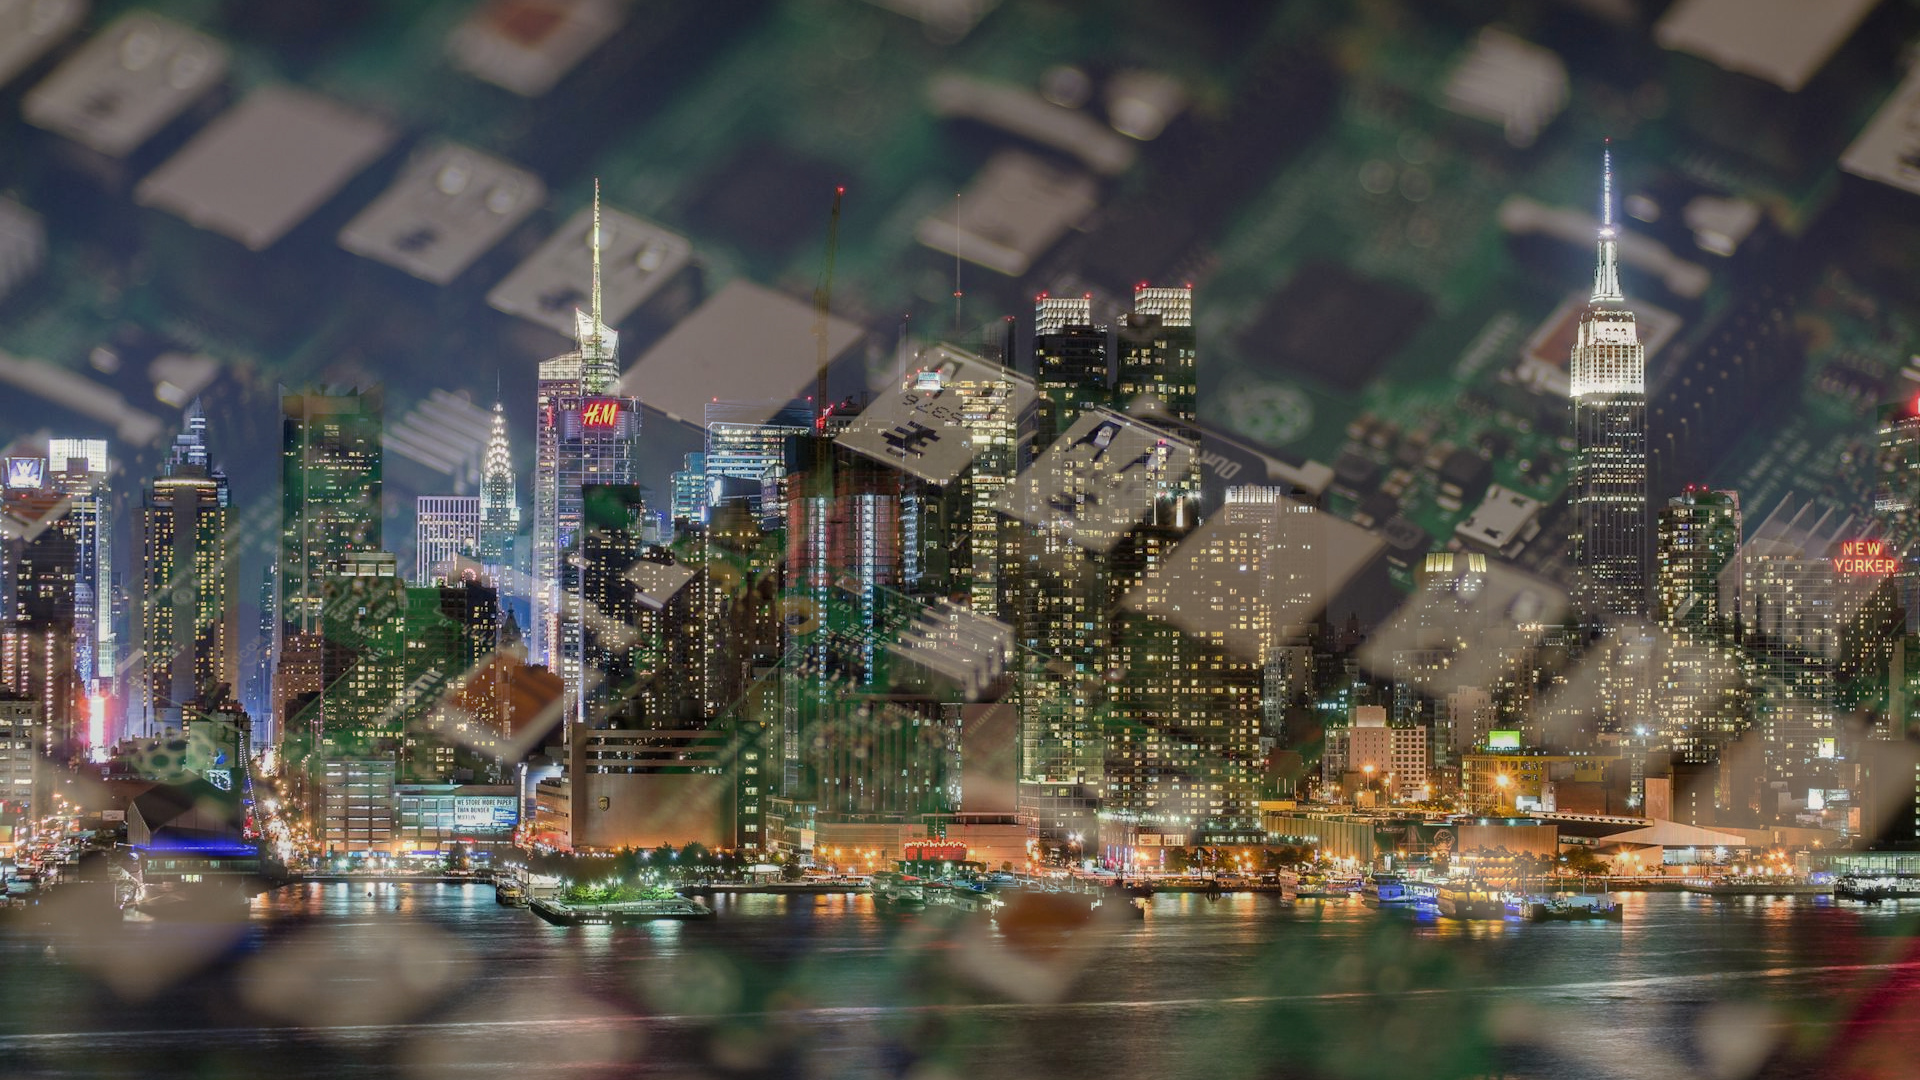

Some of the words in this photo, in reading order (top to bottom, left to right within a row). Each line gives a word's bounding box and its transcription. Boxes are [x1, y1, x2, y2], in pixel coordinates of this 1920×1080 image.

[583, 403, 617, 425] H&M
[16, 462, 34, 475] W
[1843, 542, 1881, 555] NEW
[1834, 559, 1896, 573] YORKER
